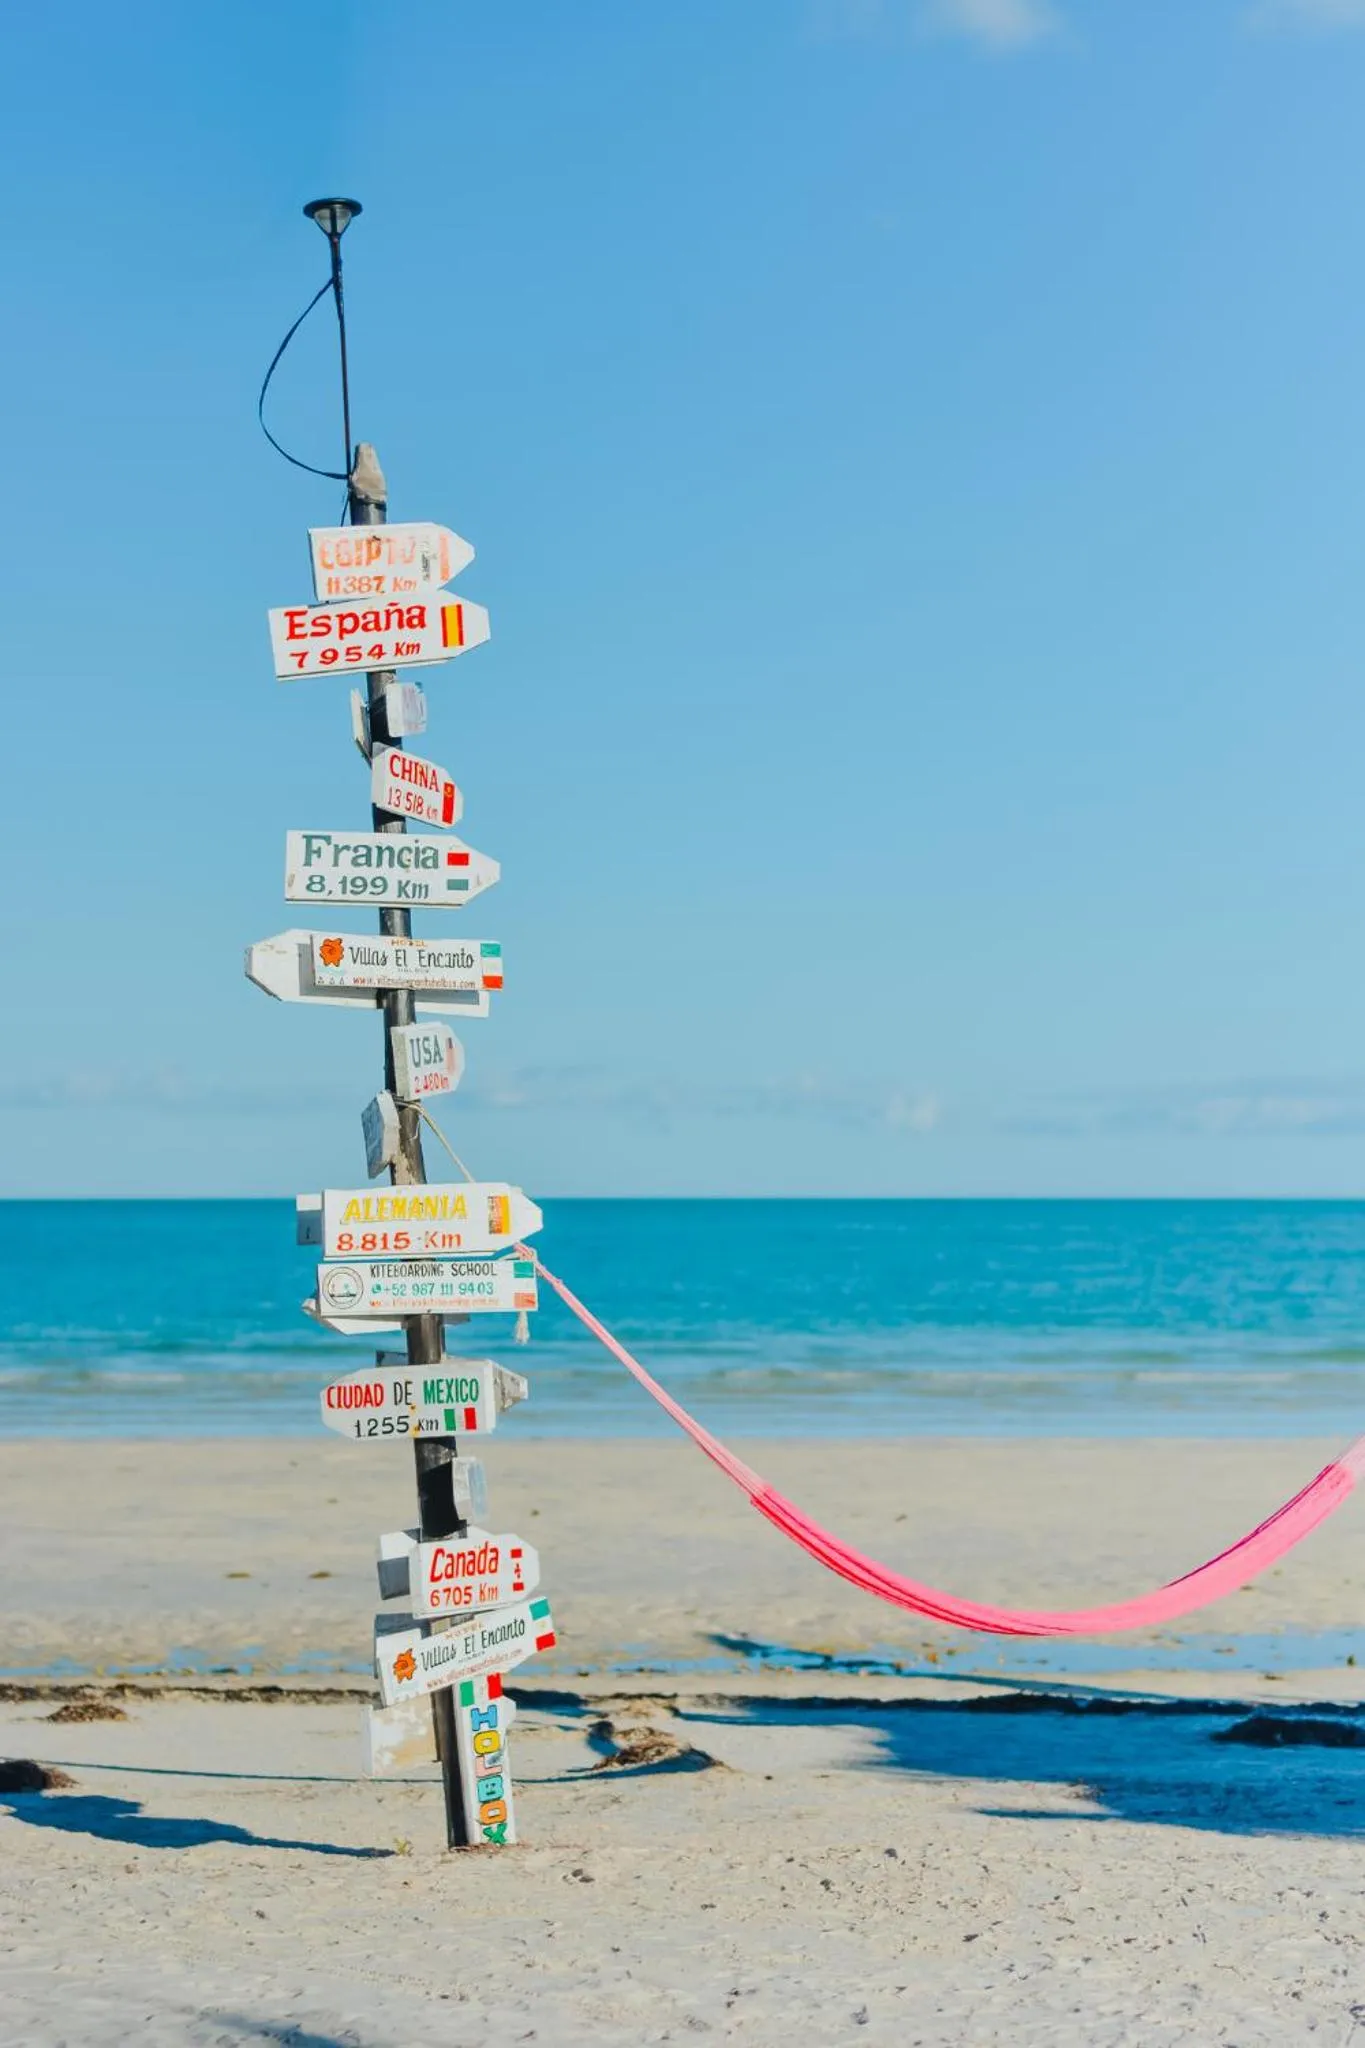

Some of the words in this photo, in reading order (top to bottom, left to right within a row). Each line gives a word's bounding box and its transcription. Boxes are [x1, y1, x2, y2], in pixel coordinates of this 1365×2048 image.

[393, 576, 416, 592] Km
[284, 602, 426, 641] España
[394, 642, 420, 657] Km
[389, 754, 440, 793] CHINA
[302, 834, 439, 869] Francia
[306, 874, 388, 896] 8,199
[397, 879, 429, 899] Km
[349, 947, 388, 966] Villas
[396, 949, 407, 968] El
[418, 947, 475, 969] Encanto
[409, 1035, 444, 1068] USA
[342, 1193, 467, 1223] ALEMANIA
[336, 1231, 411, 1251] 8.815
[425, 1231, 461, 1248] Km
[370, 1263, 444, 1278] KITEBOARDING
[451, 1262, 497, 1277] SCHOOL
[385, 1283, 407, 1296] +52
[412, 1283, 435, 1296] 987
[440, 1283, 453, 1296] 111
[327, 1383, 384, 1409] CIUDAD
[393, 1381, 413, 1406] DE
[423, 1378, 479, 1405] MEXICO
[430, 1541, 499, 1583] Canada
[430, 1585, 472, 1608] 6705
[421, 1644, 456, 1671] Villas
[464, 1634, 475, 1653] El
[481, 1618, 525, 1649] Encanto
[471, 1704, 508, 1845] HOLBOX
